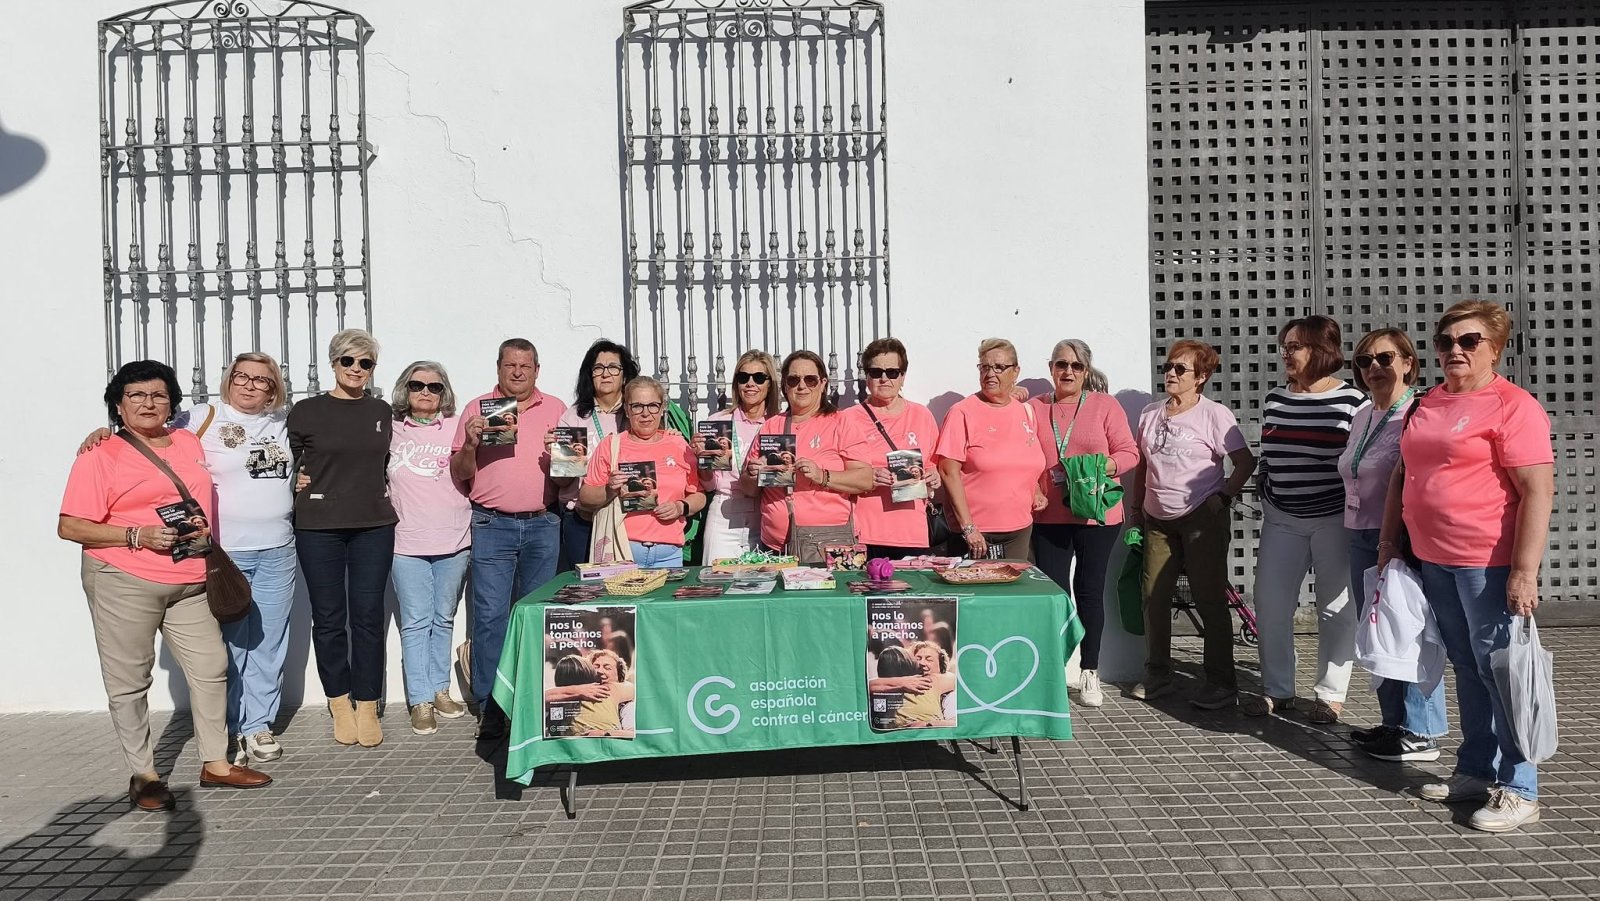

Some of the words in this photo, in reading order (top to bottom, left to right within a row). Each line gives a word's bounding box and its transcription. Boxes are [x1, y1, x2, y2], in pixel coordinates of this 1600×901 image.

[893, 610, 904, 620] lo
[572, 620, 583, 629] lo
[872, 621, 923, 629] tomamos
[550, 630, 602, 639] tomamos
[881, 630, 918, 641] pecho.
[560, 639, 596, 650] pecho.
[750, 676, 826, 692] asociación
[750, 693, 816, 712] española
[752, 713, 798, 726] contra
[802, 710, 815, 724] el
[818, 710, 868, 724] cáncer
